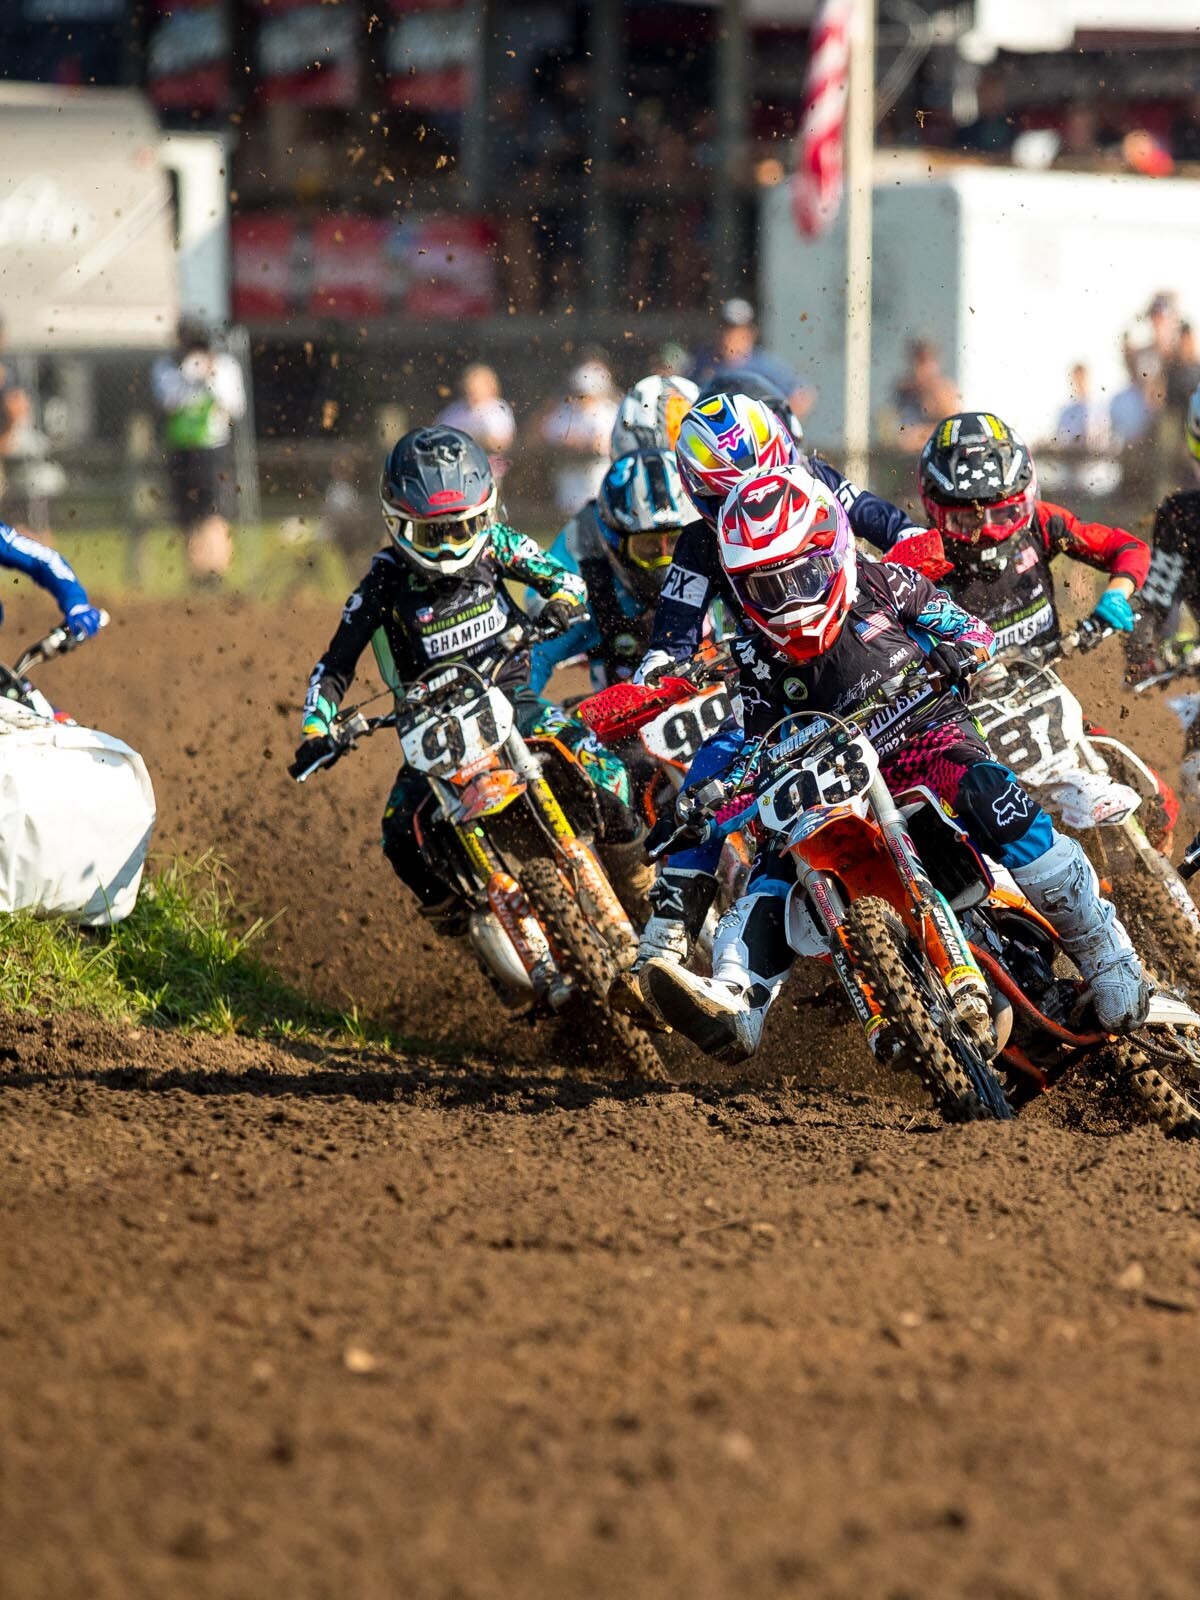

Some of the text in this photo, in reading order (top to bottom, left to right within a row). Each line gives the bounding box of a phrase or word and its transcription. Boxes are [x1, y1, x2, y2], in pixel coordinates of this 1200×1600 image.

[430, 614, 500, 656] CHAMPIO
[889, 647, 910, 669] AMA
[421, 695, 500, 777] 91
[771, 720, 828, 760] PROTAPER
[987, 696, 1069, 773] 87
[773, 743, 871, 822] 93
[934, 905, 967, 968] DUNLOP
